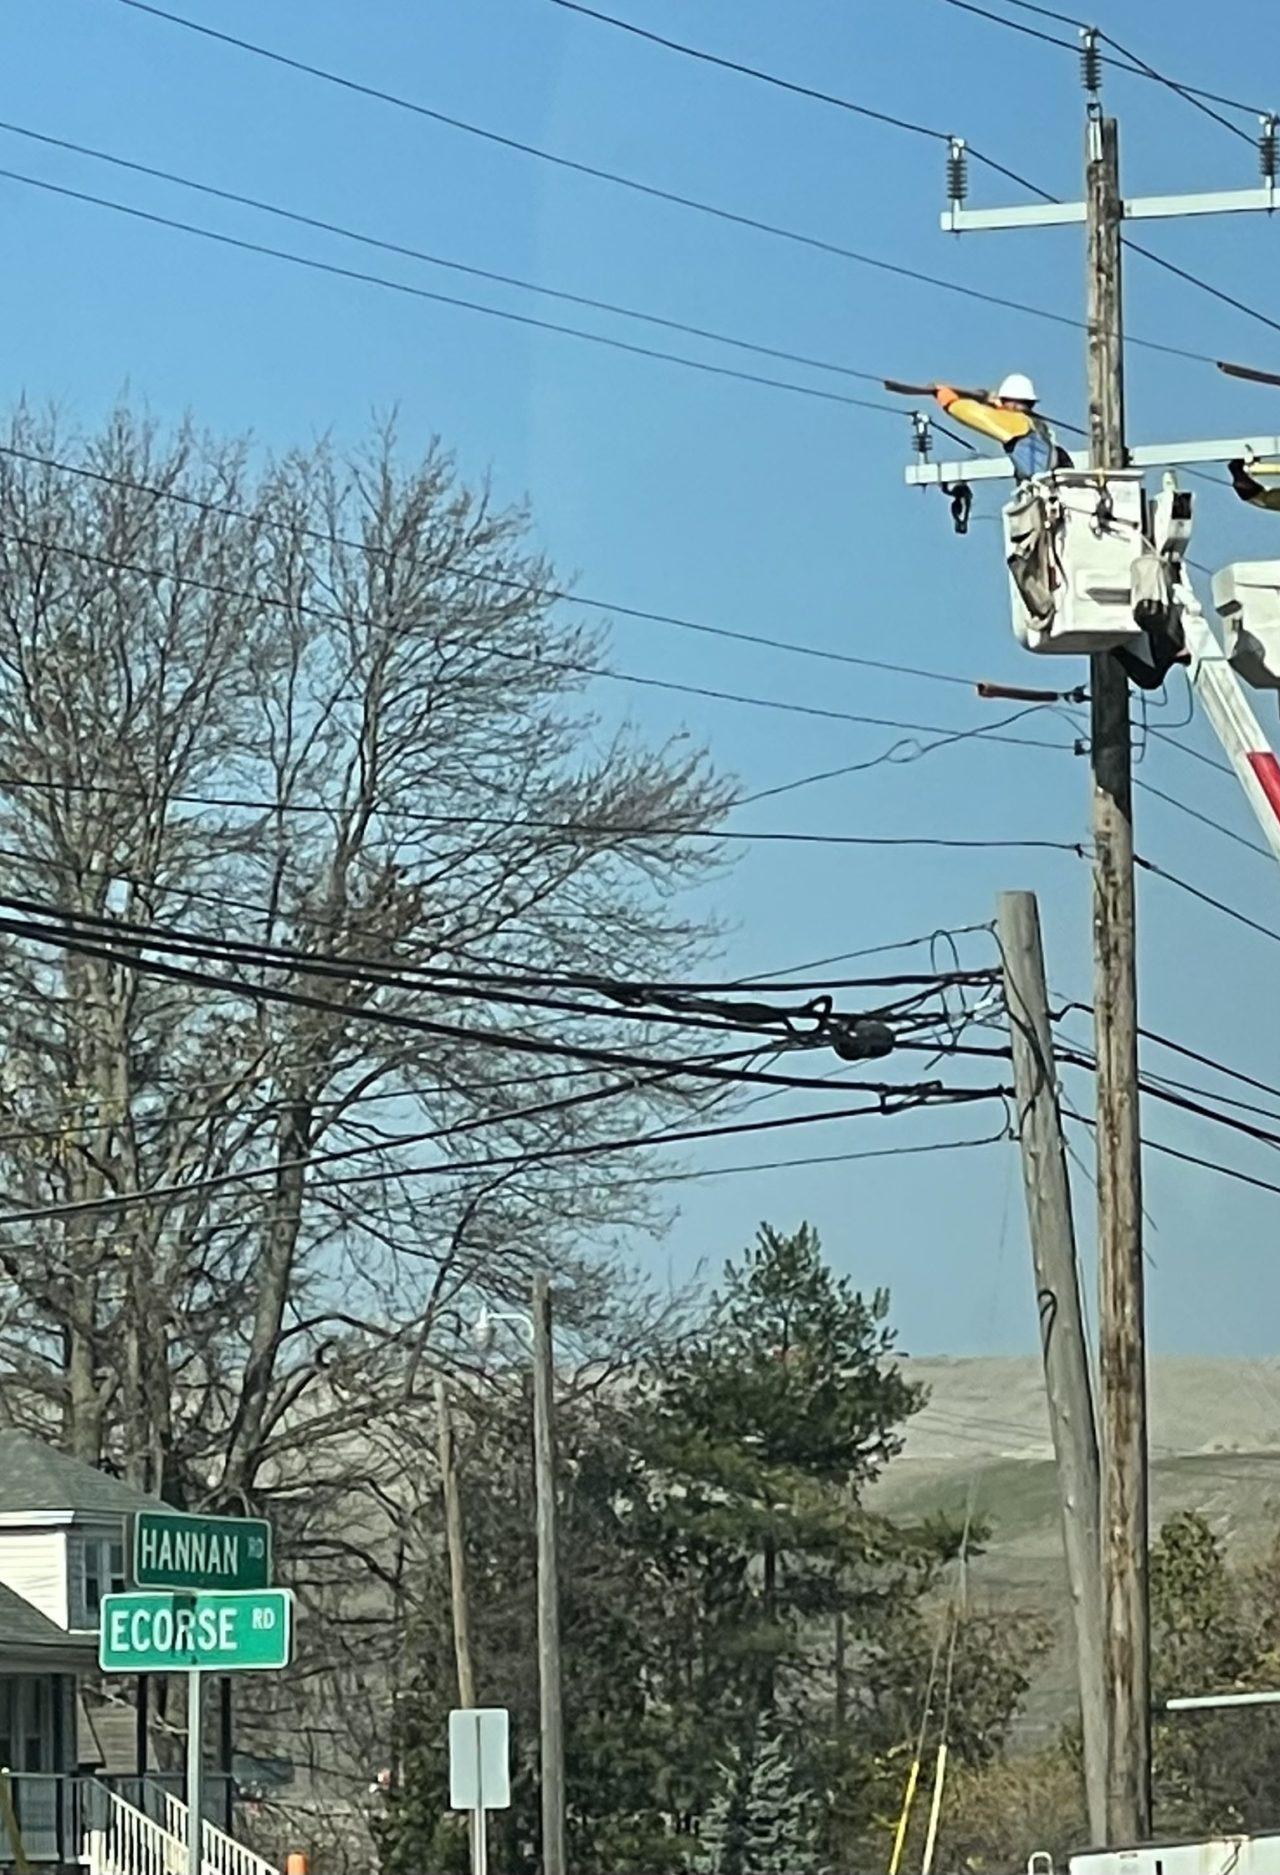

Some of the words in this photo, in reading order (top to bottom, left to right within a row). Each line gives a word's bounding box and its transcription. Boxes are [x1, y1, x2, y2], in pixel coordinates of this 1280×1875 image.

[141, 1528, 239, 1575] HANNAN
[247, 1536, 265, 1559] RD
[110, 1607, 239, 1653] ECORSE
[251, 1607, 276, 1630] RD
